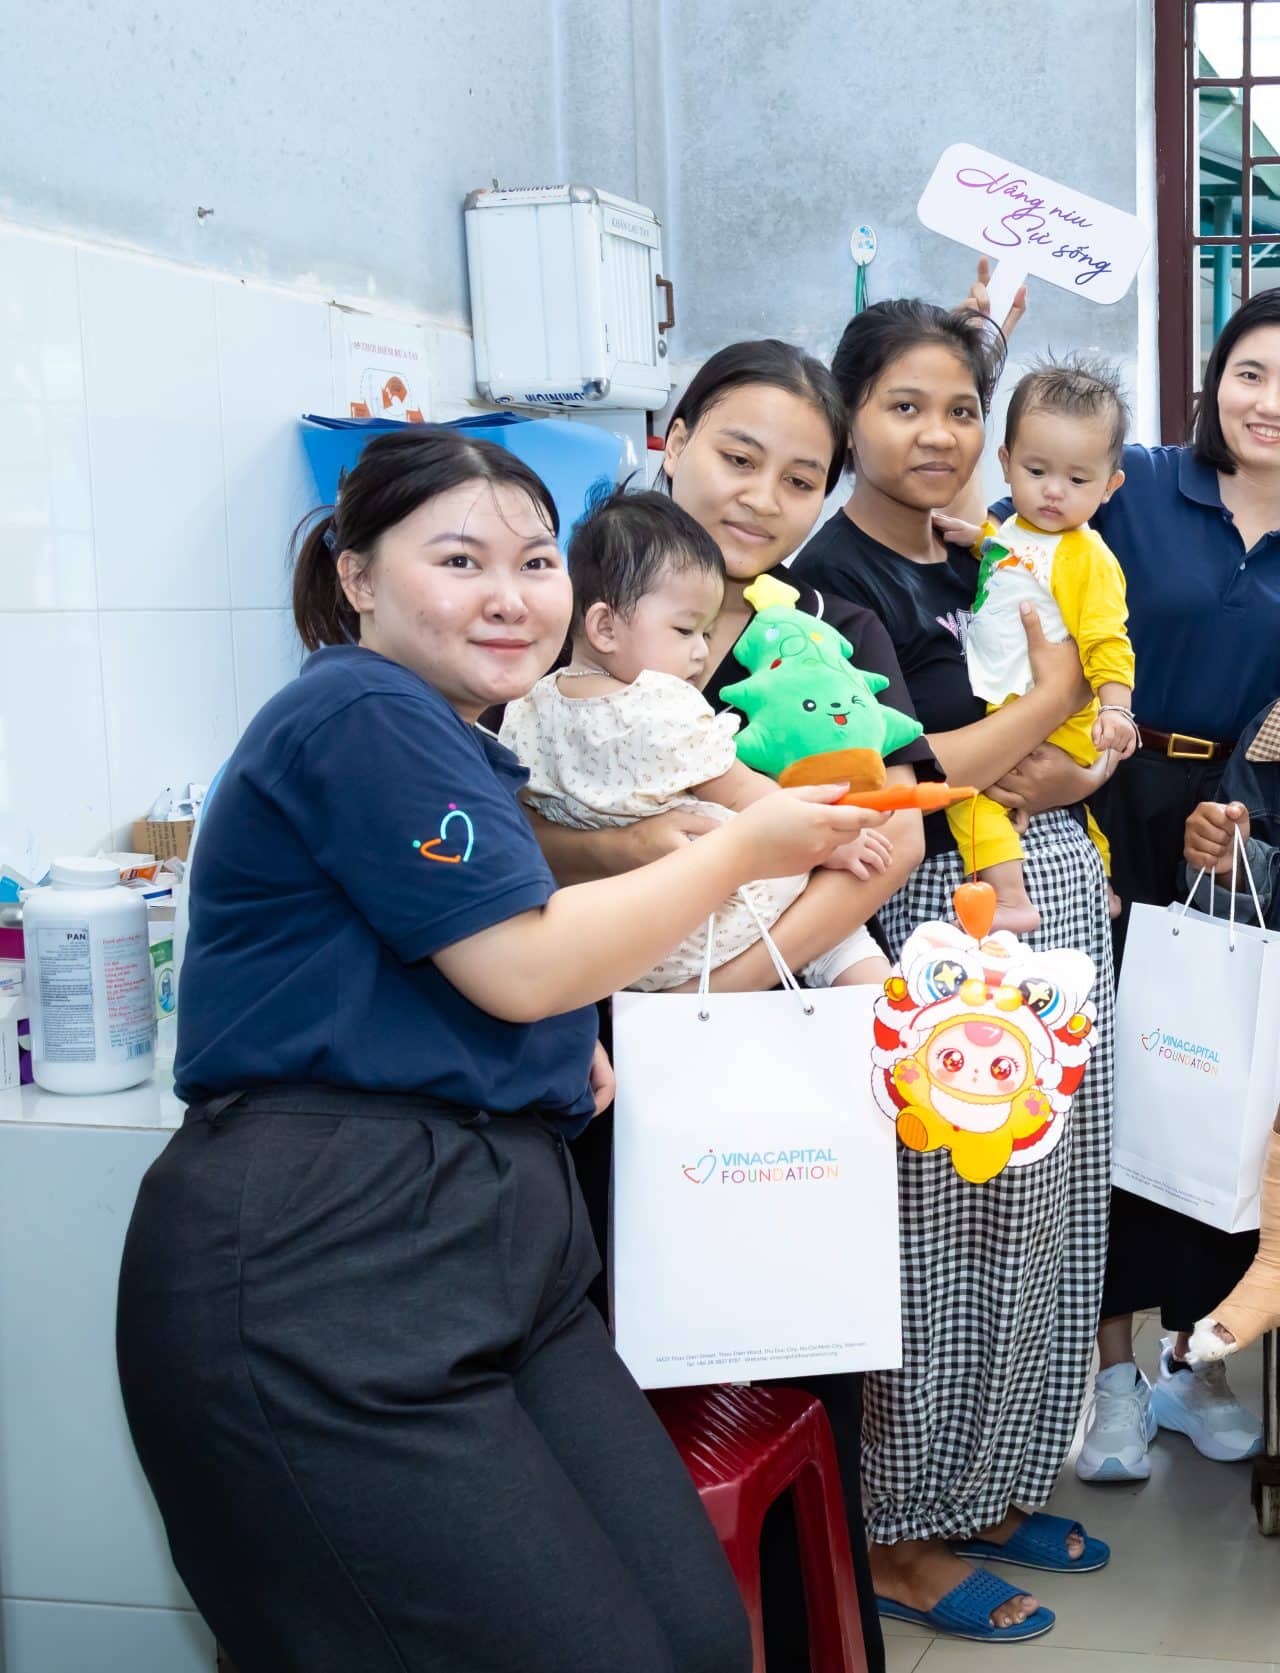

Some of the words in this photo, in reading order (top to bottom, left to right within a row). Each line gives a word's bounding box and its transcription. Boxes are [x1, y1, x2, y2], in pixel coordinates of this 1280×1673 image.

[956, 168, 1045, 219] Nâng
[1049, 206, 1092, 228] niu
[982, 213, 1052, 246] Sự
[1052, 244, 1112, 285] sống
[1159, 1046, 1218, 1077] FOUNDATION
[1162, 1033, 1220, 1063] VINACAPITAL
[721, 1148, 839, 1167] VINACAPITAL
[721, 1165, 839, 1185] FOUNDATION
